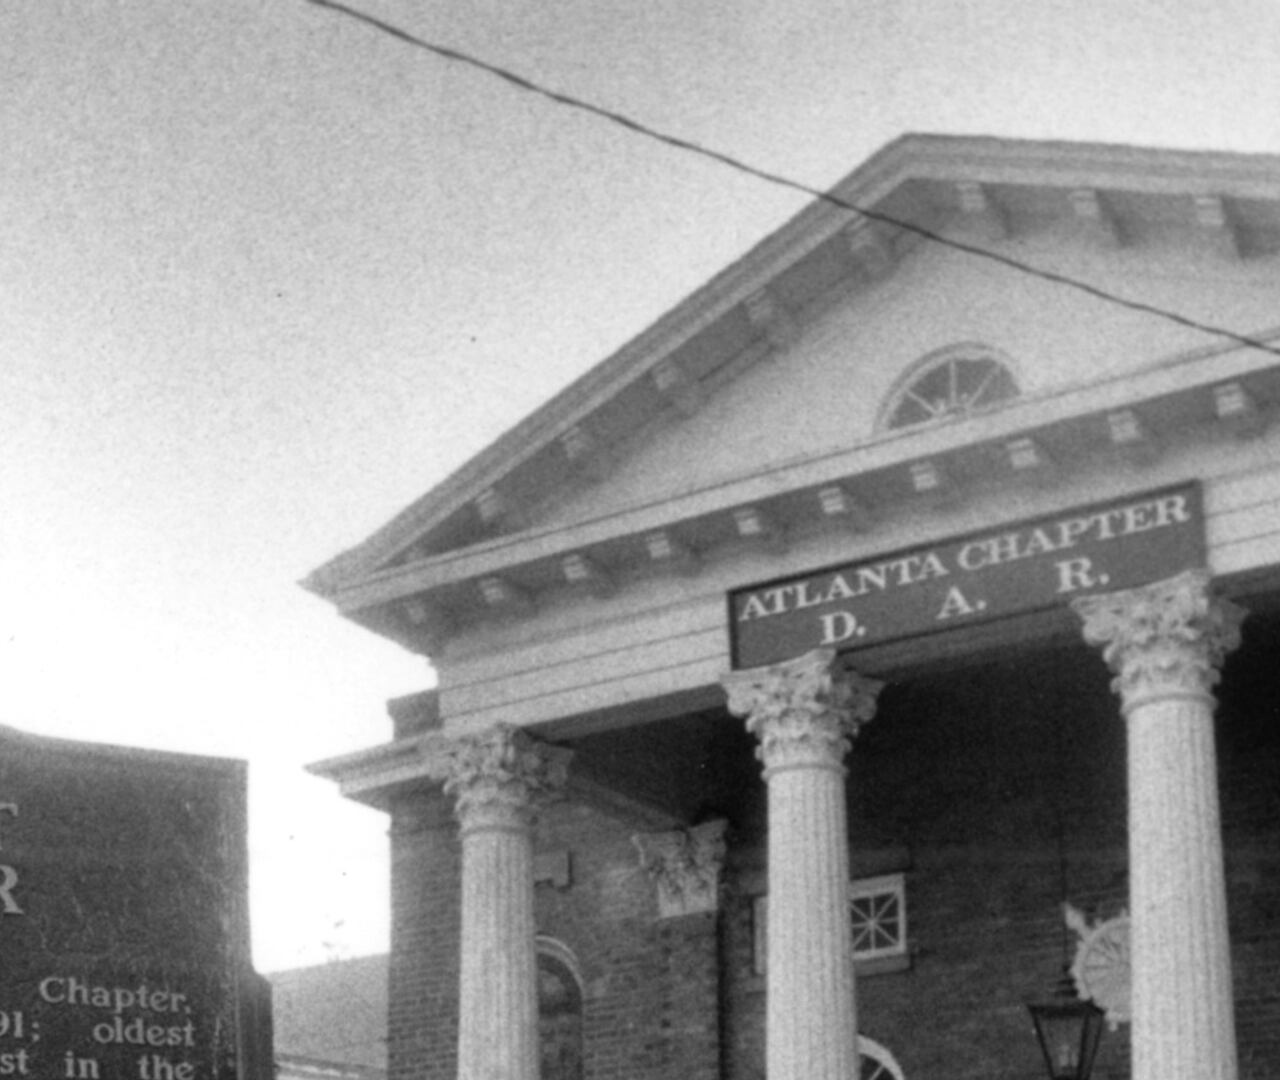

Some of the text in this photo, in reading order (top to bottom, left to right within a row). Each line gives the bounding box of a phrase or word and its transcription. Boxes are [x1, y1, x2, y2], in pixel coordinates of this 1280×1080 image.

[739, 494, 1190, 621] ATLANTA CHAPTER
[821, 557, 1109, 644] D. A. R.
[38, 976, 191, 1014] Chapter,
[92, 1015, 195, 1047] oldest
[65, 1050, 99, 1079] in
